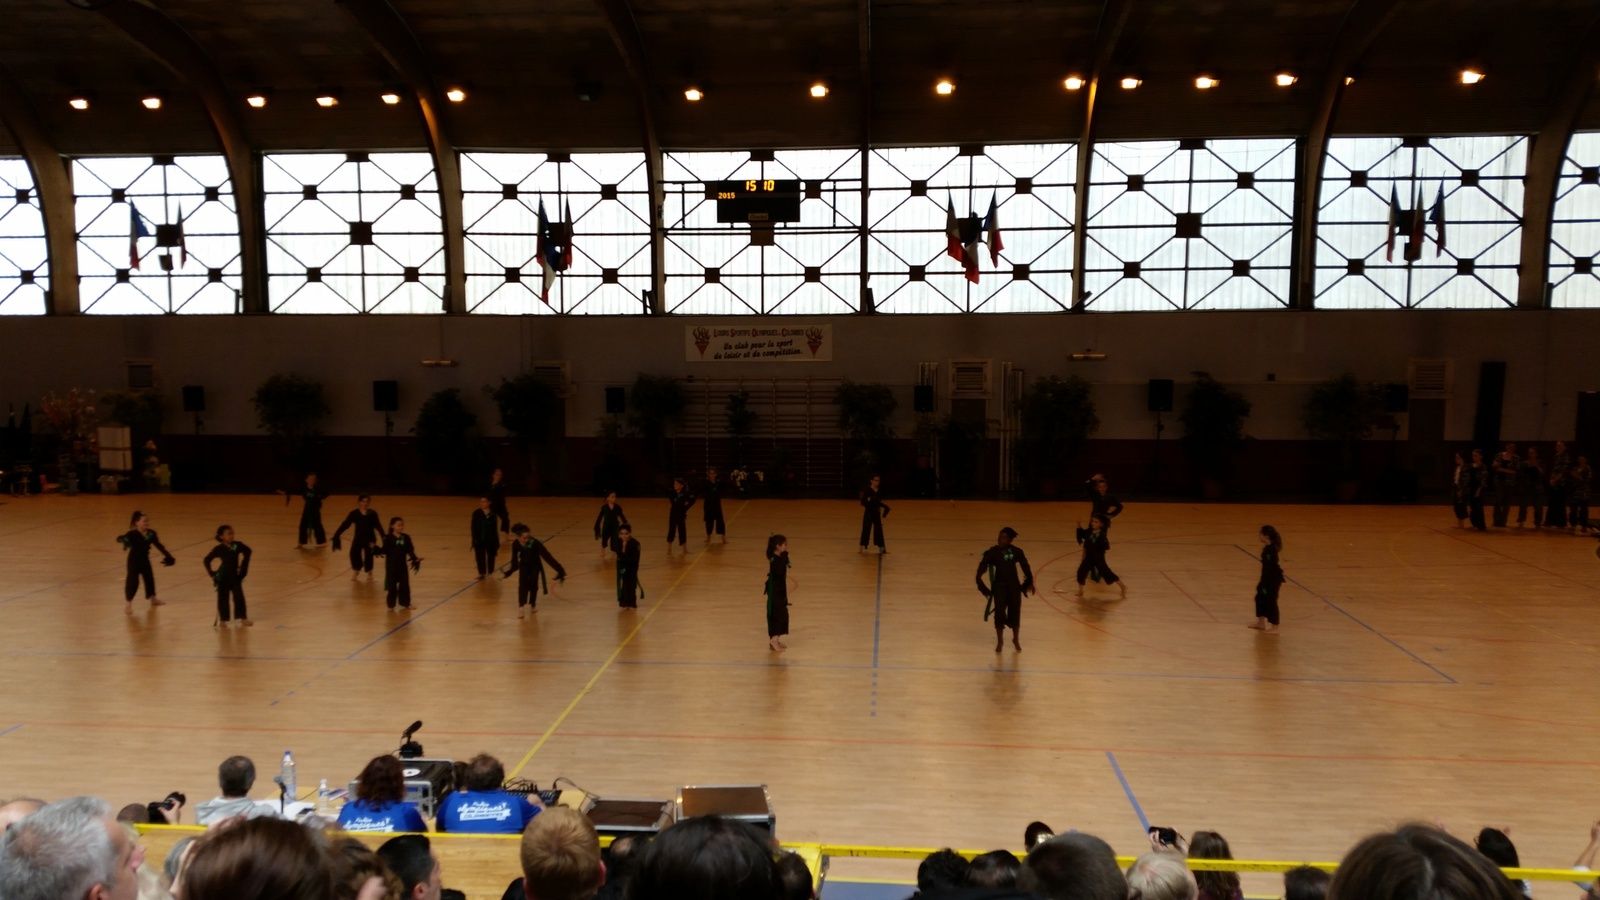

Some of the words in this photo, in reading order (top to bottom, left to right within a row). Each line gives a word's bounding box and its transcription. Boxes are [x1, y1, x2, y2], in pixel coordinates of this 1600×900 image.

[745, 179, 757, 191] 15
[763, 179, 775, 191] 10
[723, 342, 732, 350] Un
[735, 341, 749, 349] club
[750, 342, 766, 350] pour
[776, 339, 793, 348] sport
[714, 352, 722, 360] de
[723, 351, 741, 360] loisir
[752, 350, 761, 358] de
